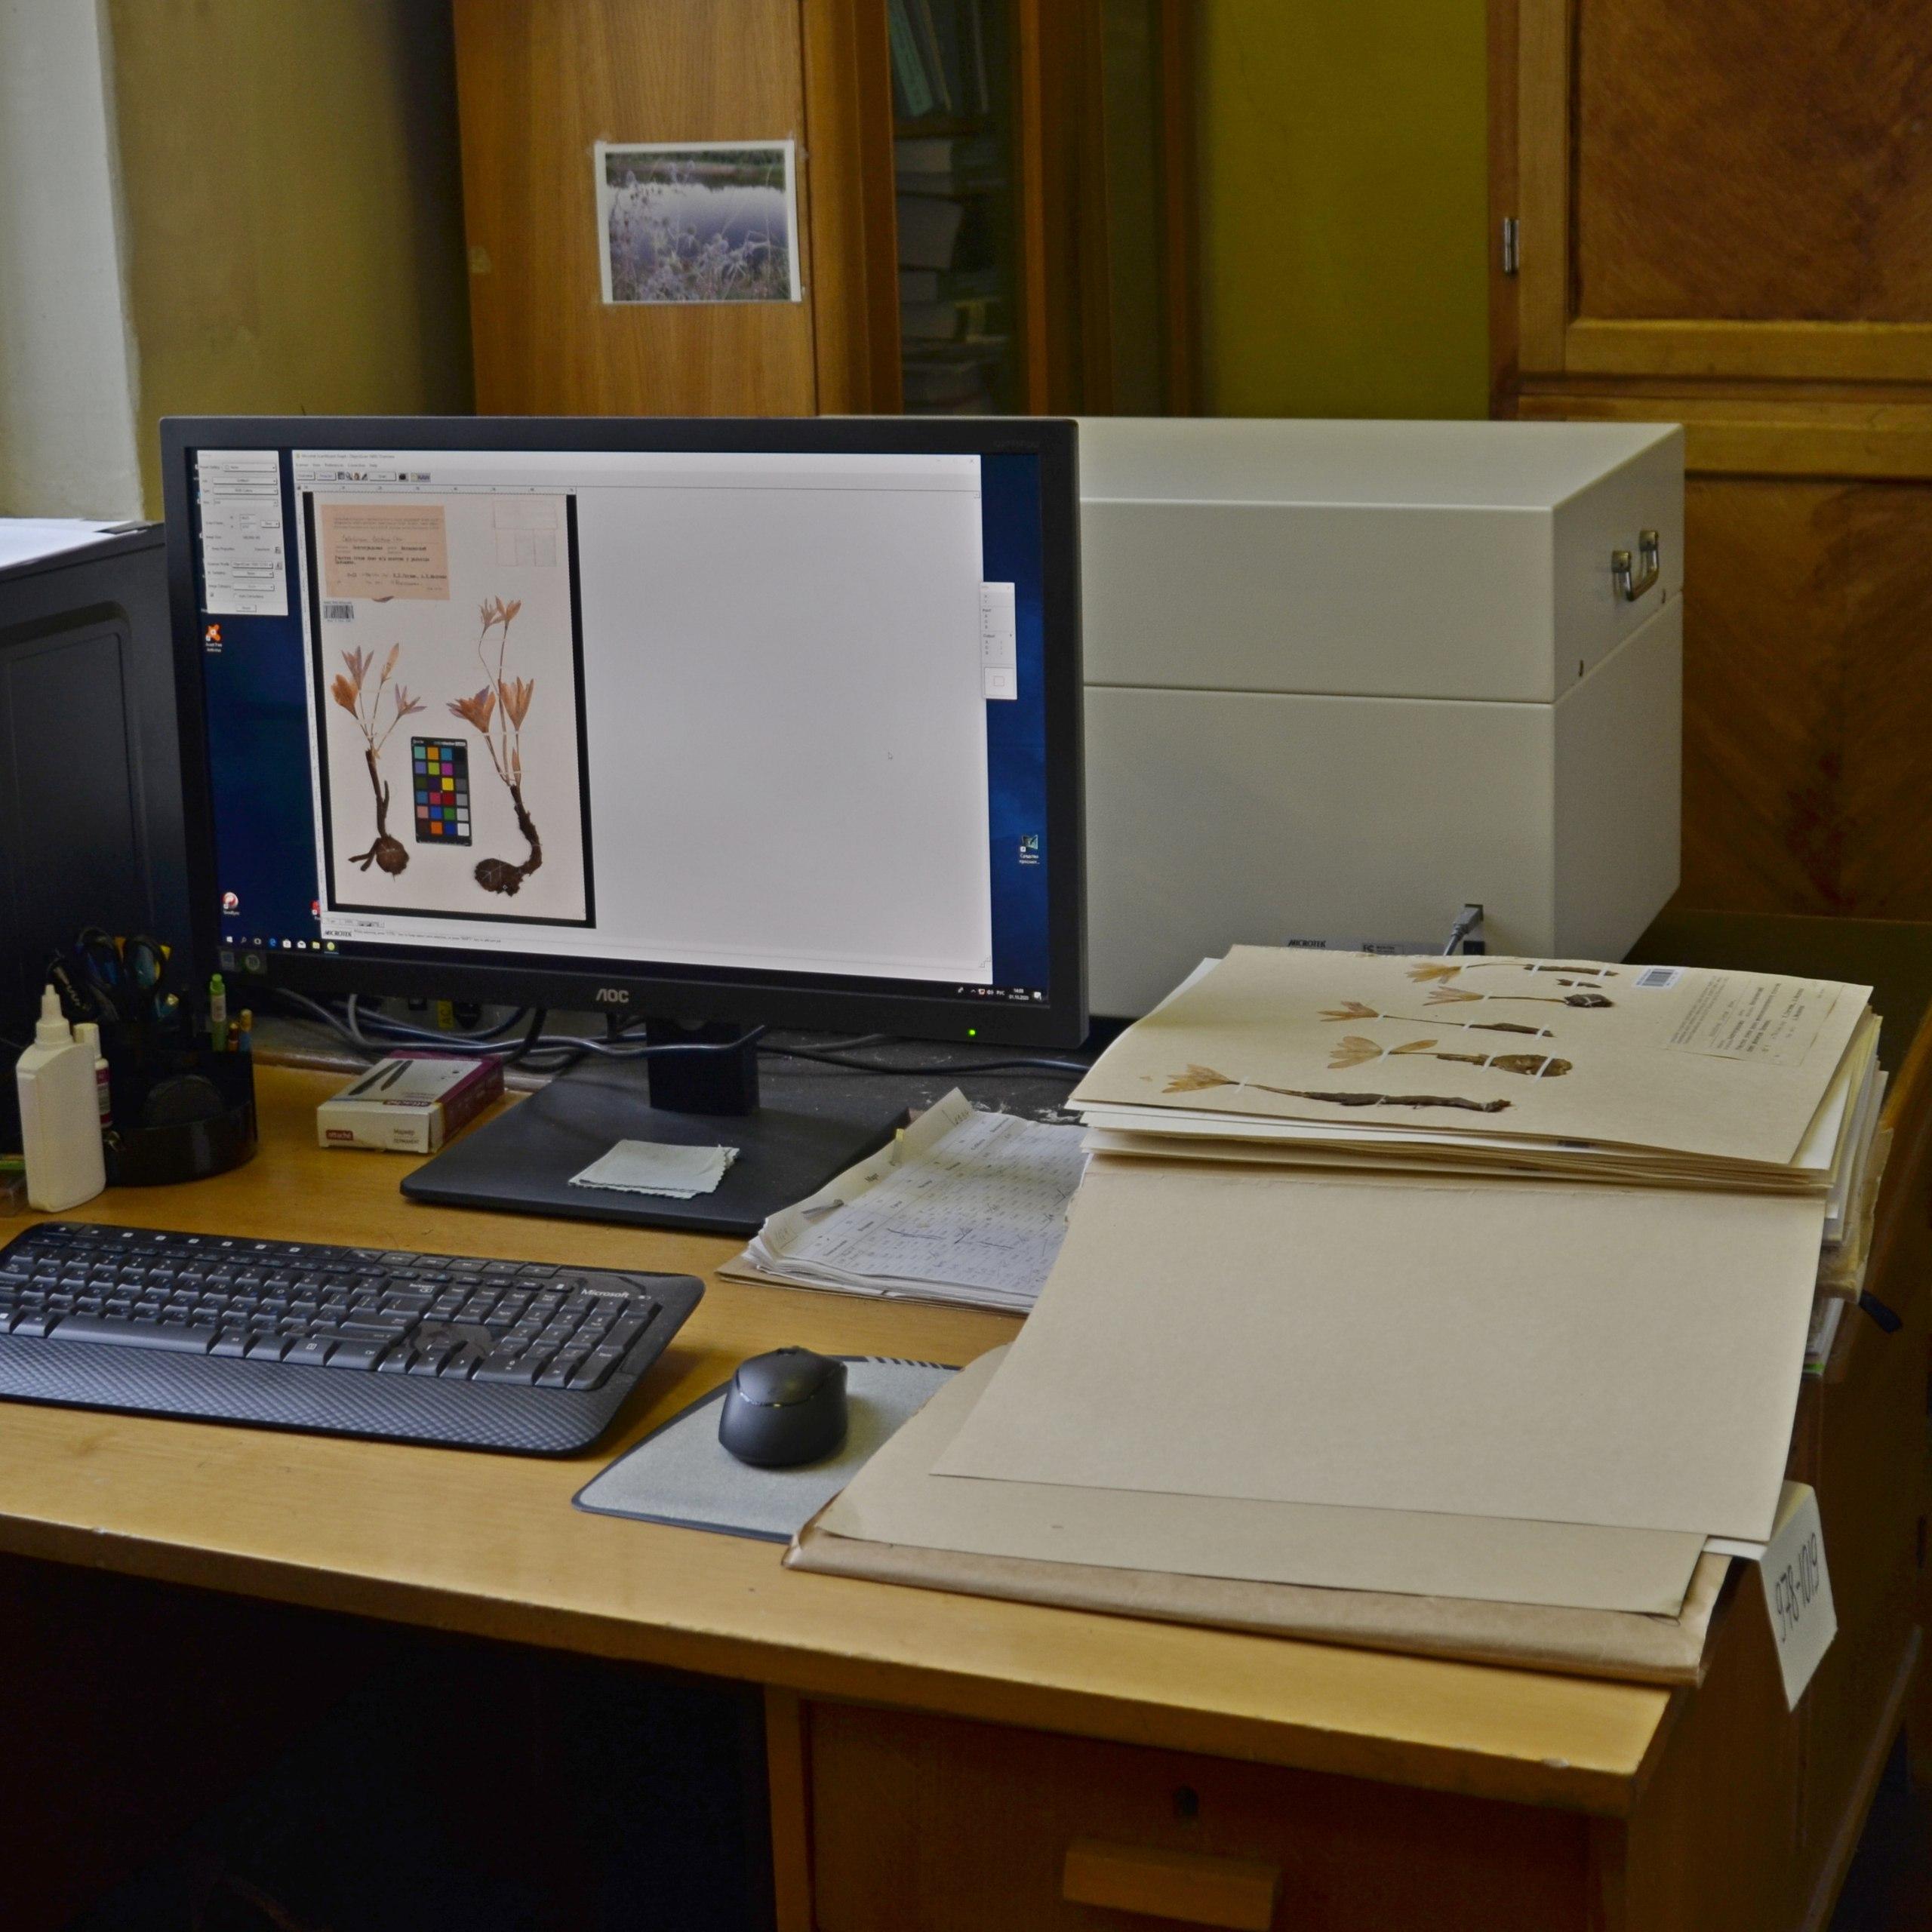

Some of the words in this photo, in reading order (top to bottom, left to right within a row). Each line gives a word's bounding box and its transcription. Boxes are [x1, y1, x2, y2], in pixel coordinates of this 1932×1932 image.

[1288, 940, 1327, 949] MICROTEK
[595, 988, 629, 1003] AOC
[580, 1289, 629, 1298] Microsoft
[1775, 1533, 1819, 1644] 978-1019
